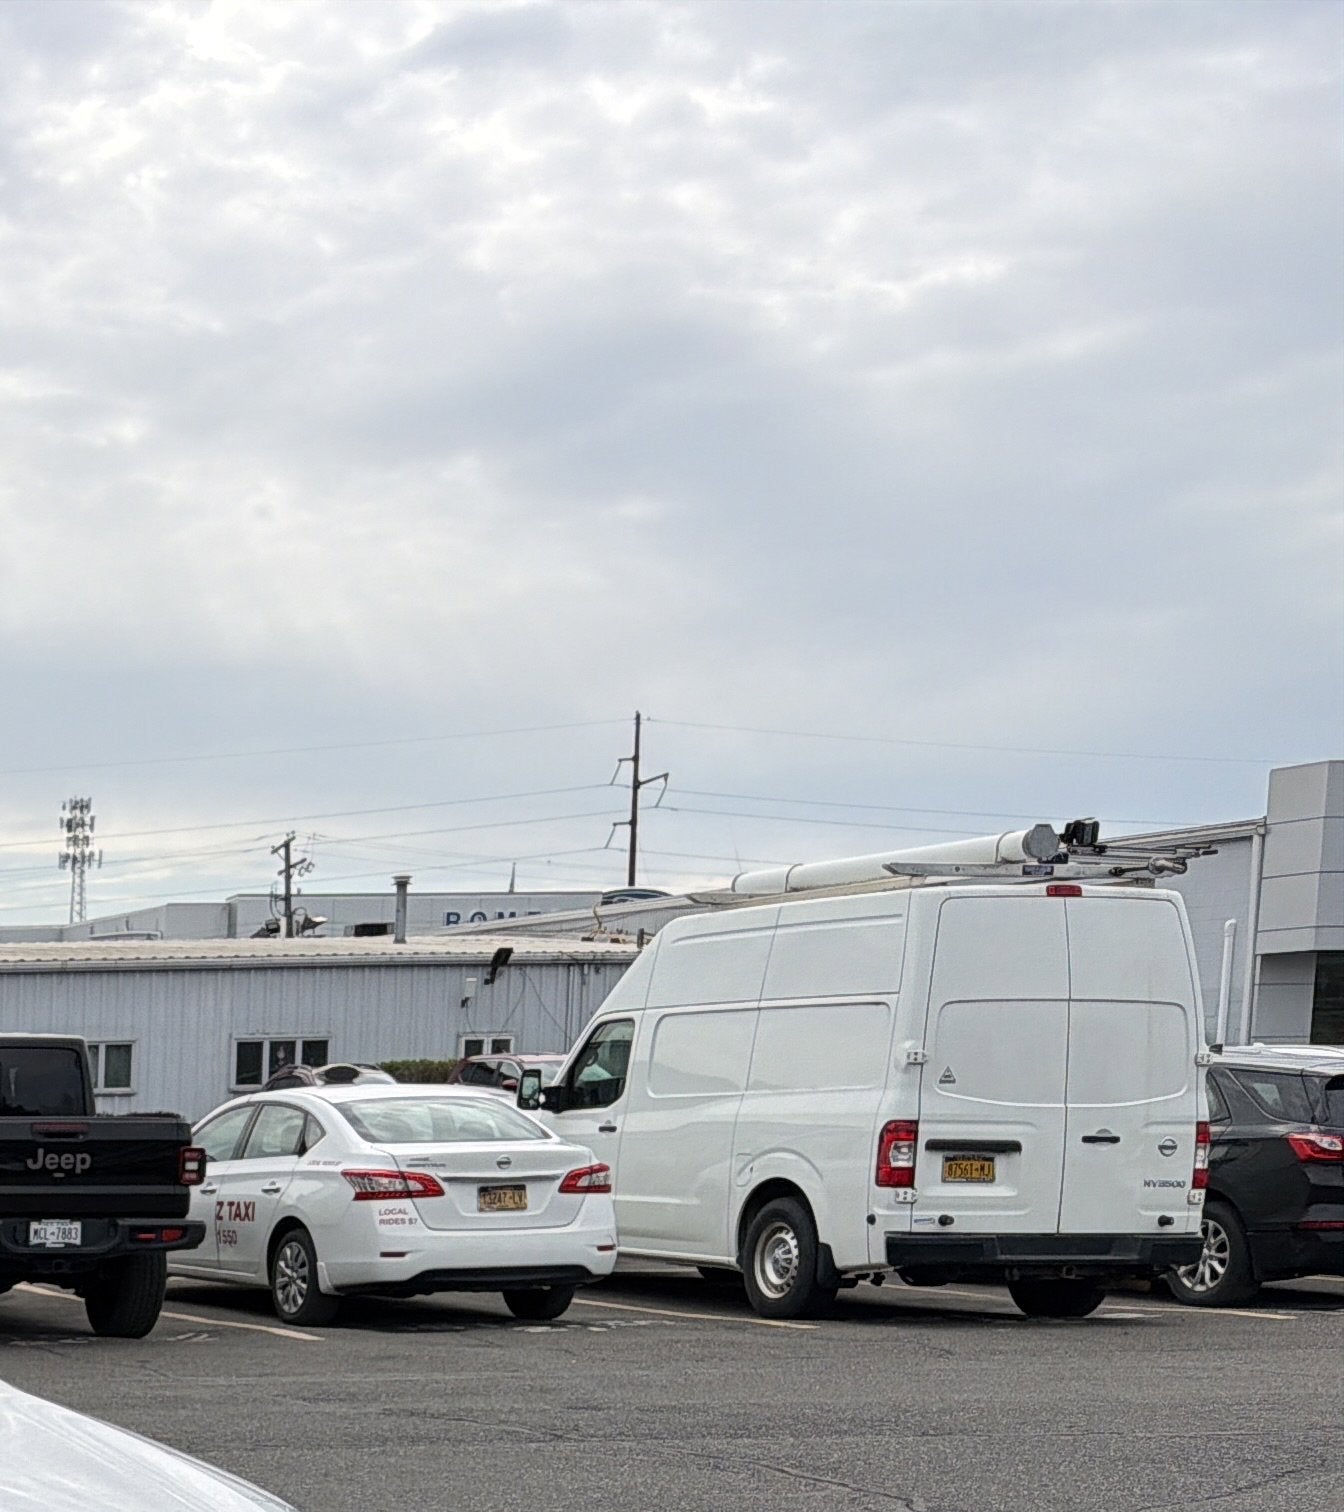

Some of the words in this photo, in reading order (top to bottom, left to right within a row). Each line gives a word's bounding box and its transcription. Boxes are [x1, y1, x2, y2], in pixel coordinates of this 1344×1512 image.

[27, 1148, 92, 1174] Jeep
[227, 1201, 256, 1222] TAXI
[378, 1208, 409, 1216] LOCAL
[378, 1217, 407, 1226] RIDES
